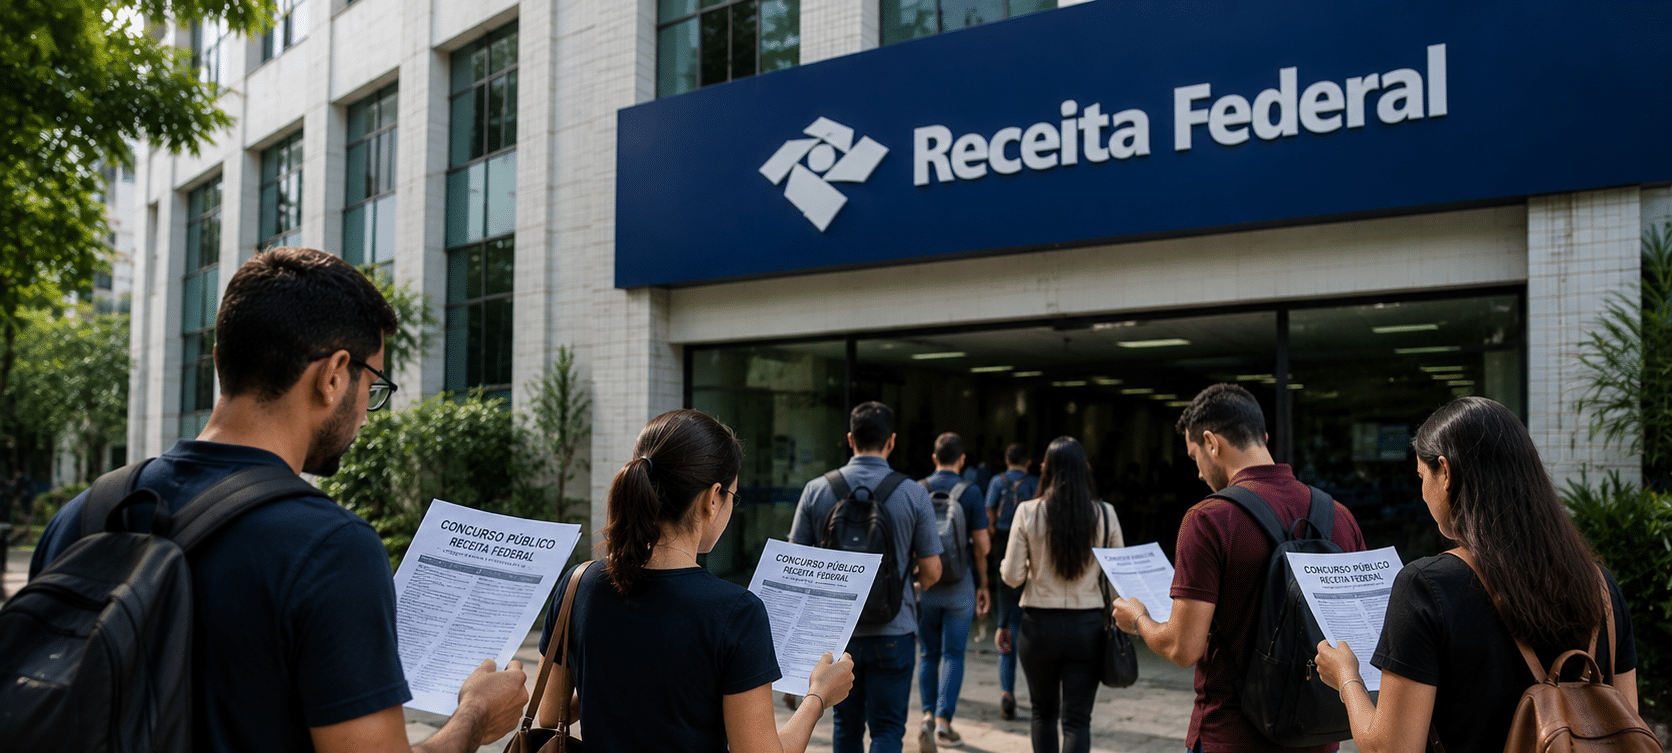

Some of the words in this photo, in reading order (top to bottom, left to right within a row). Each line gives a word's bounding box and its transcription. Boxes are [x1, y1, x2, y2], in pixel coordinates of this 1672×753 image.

[913, 98, 1151, 187] Receita
[1173, 43, 1448, 153] Federal
[440, 519, 505, 543] CONCURSO
[505, 533, 556, 550] PÚBLICO
[449, 537, 489, 554] RECEITA
[491, 545, 535, 562] FEDERAL
[775, 553, 825, 569] CONCURSO
[826, 561, 866, 574] PÚBLICO
[1303, 565, 1352, 574] CONCURSO
[1352, 560, 1390, 572] PÚBLICO
